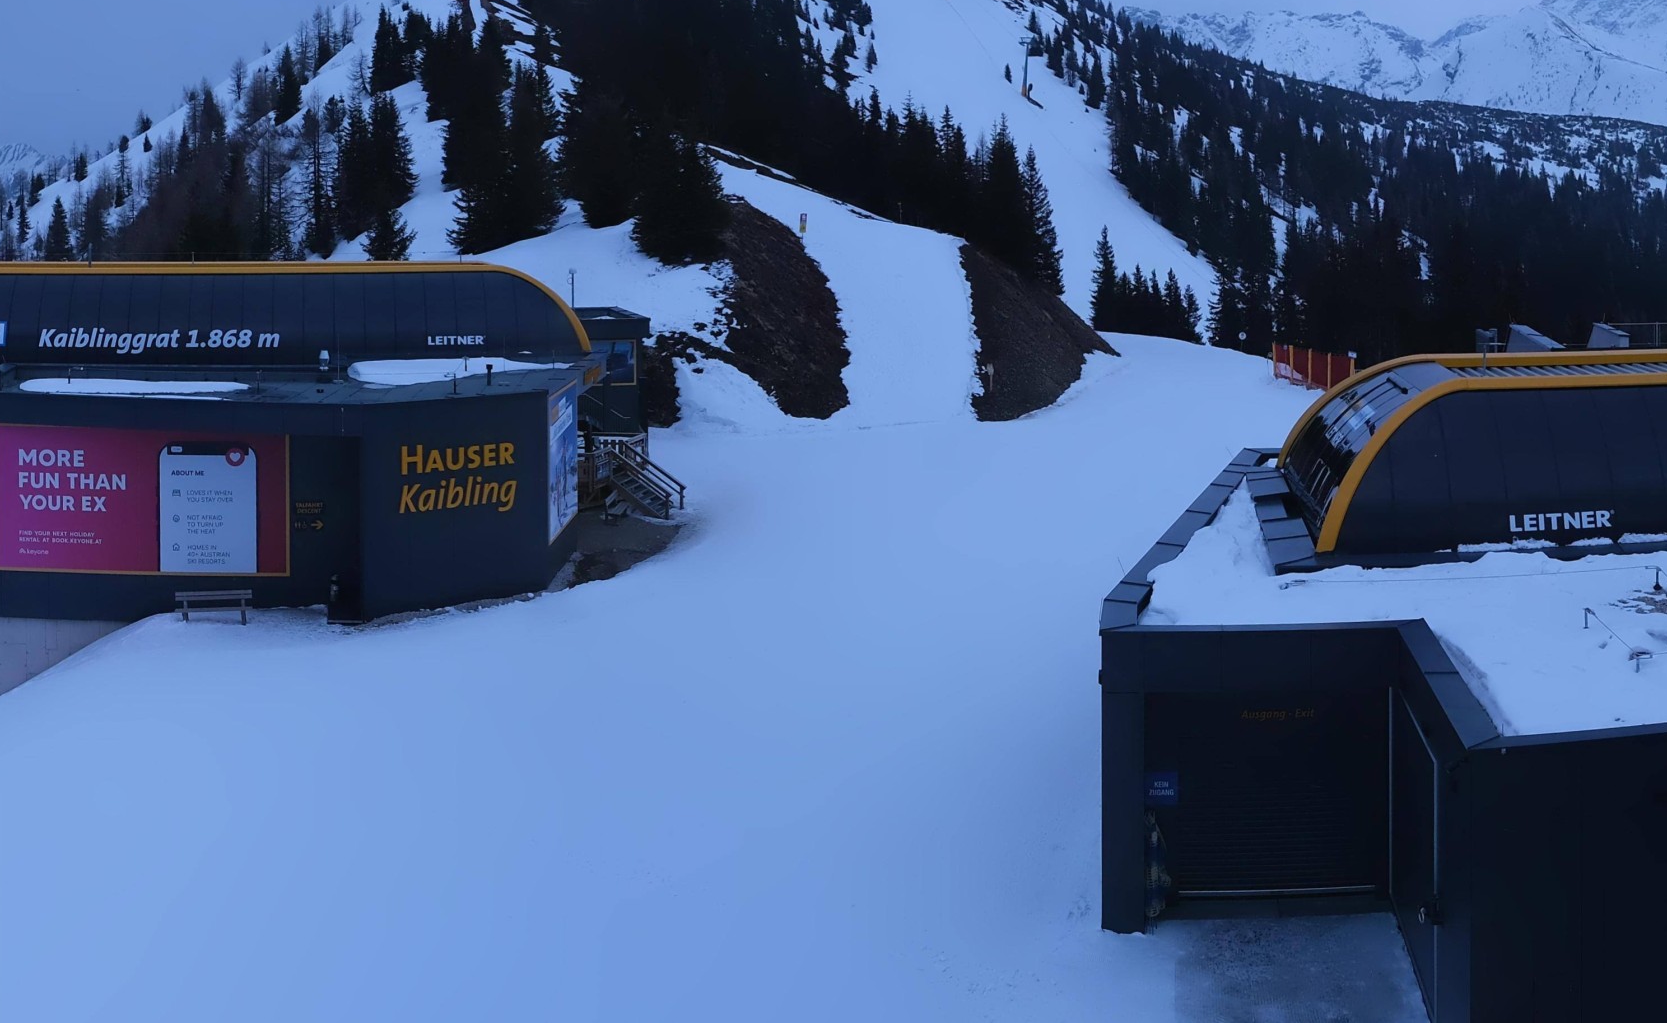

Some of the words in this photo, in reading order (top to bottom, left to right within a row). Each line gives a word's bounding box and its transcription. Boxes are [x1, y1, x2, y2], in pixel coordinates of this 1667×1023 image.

[38, 327, 179, 354] Kaiblinggrat
[185, 329, 252, 348] 1.868
[257, 332, 280, 348] m
[427, 335, 485, 346] LEITNER
[18, 448, 85, 468] MORE
[400, 442, 516, 475] HAUSER
[18, 471, 60, 489] FUN
[66, 473, 127, 490] THAN
[19, 494, 75, 511] YOUR
[81, 496, 107, 512] EX
[398, 476, 518, 514] Kaibling
[1509, 510, 1613, 532] LEITNER
[26, 548, 49, 556] keyone
[1241, 709, 1287, 721] Ausgang
[1295, 707, 1315, 718] Exit
